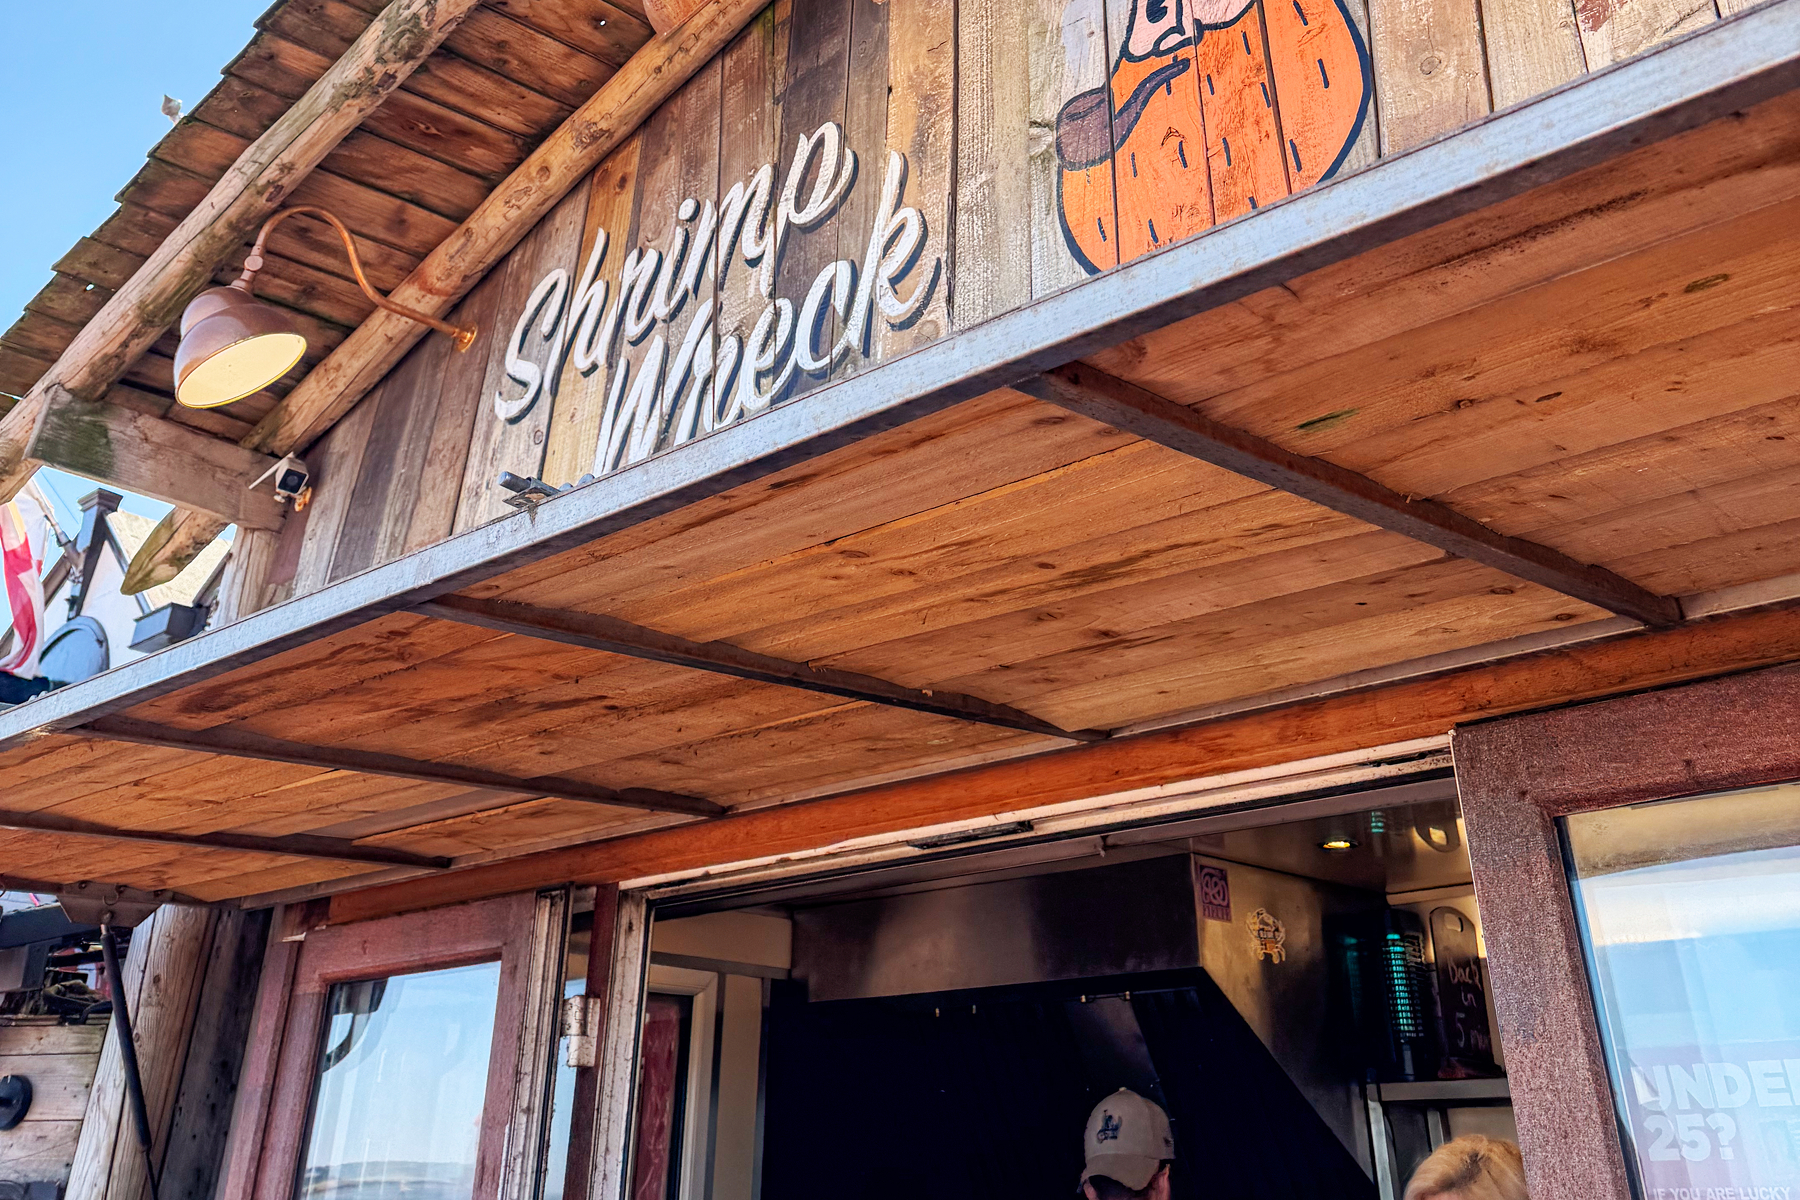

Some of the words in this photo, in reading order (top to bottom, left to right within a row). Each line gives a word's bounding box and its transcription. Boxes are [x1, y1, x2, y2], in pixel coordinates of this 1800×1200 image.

[495, 120, 855, 423] Shrimp
[592, 150, 941, 476] Wreck
[1643, 1112, 1737, 1162] 25?
[1653, 1187, 1667, 1200] IF
[1669, 1187, 1701, 1200] YOU
[1706, 1186, 1735, 1200] ARE
[1739, 1186, 1791, 1200] LUCKY
